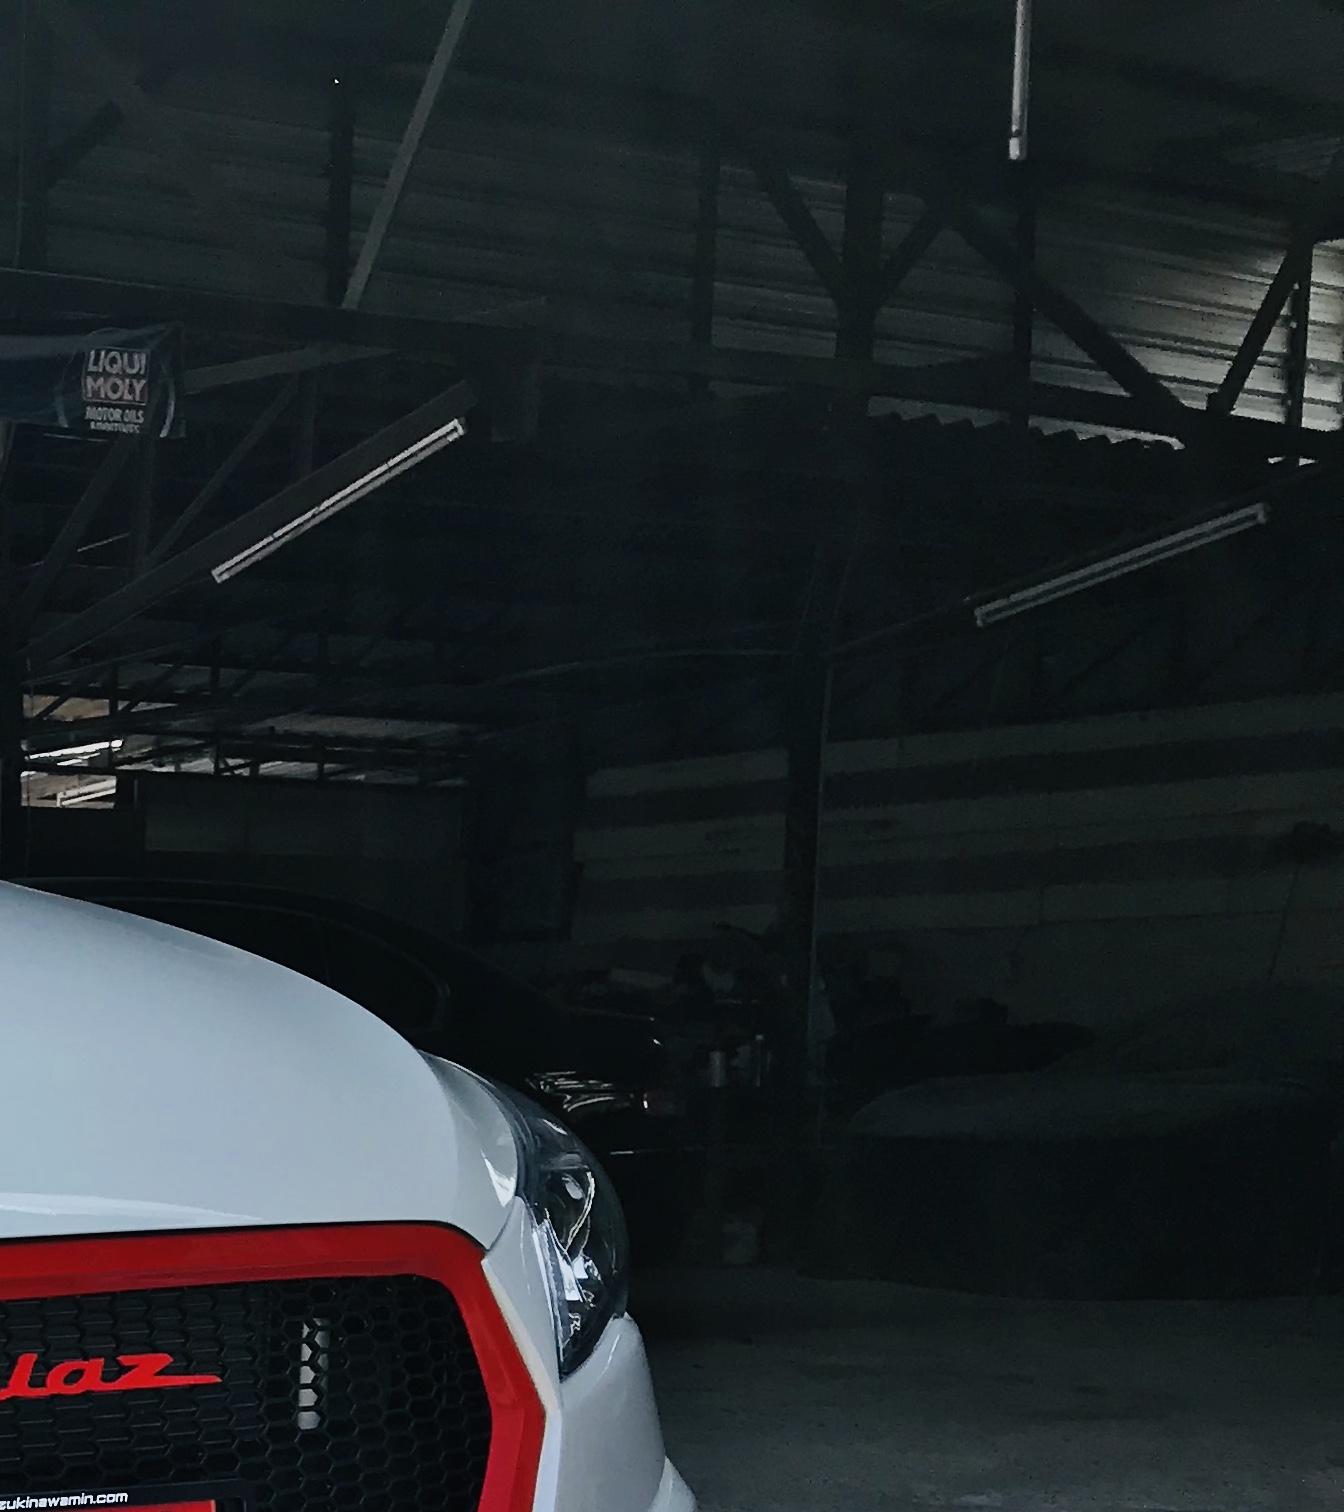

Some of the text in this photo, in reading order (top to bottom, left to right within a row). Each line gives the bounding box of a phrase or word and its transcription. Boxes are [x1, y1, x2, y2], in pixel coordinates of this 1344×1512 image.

[87, 349, 147, 375] LIQUI
[85, 375, 146, 402] MOLY
[84, 406, 144, 424] MOTOR OILS
